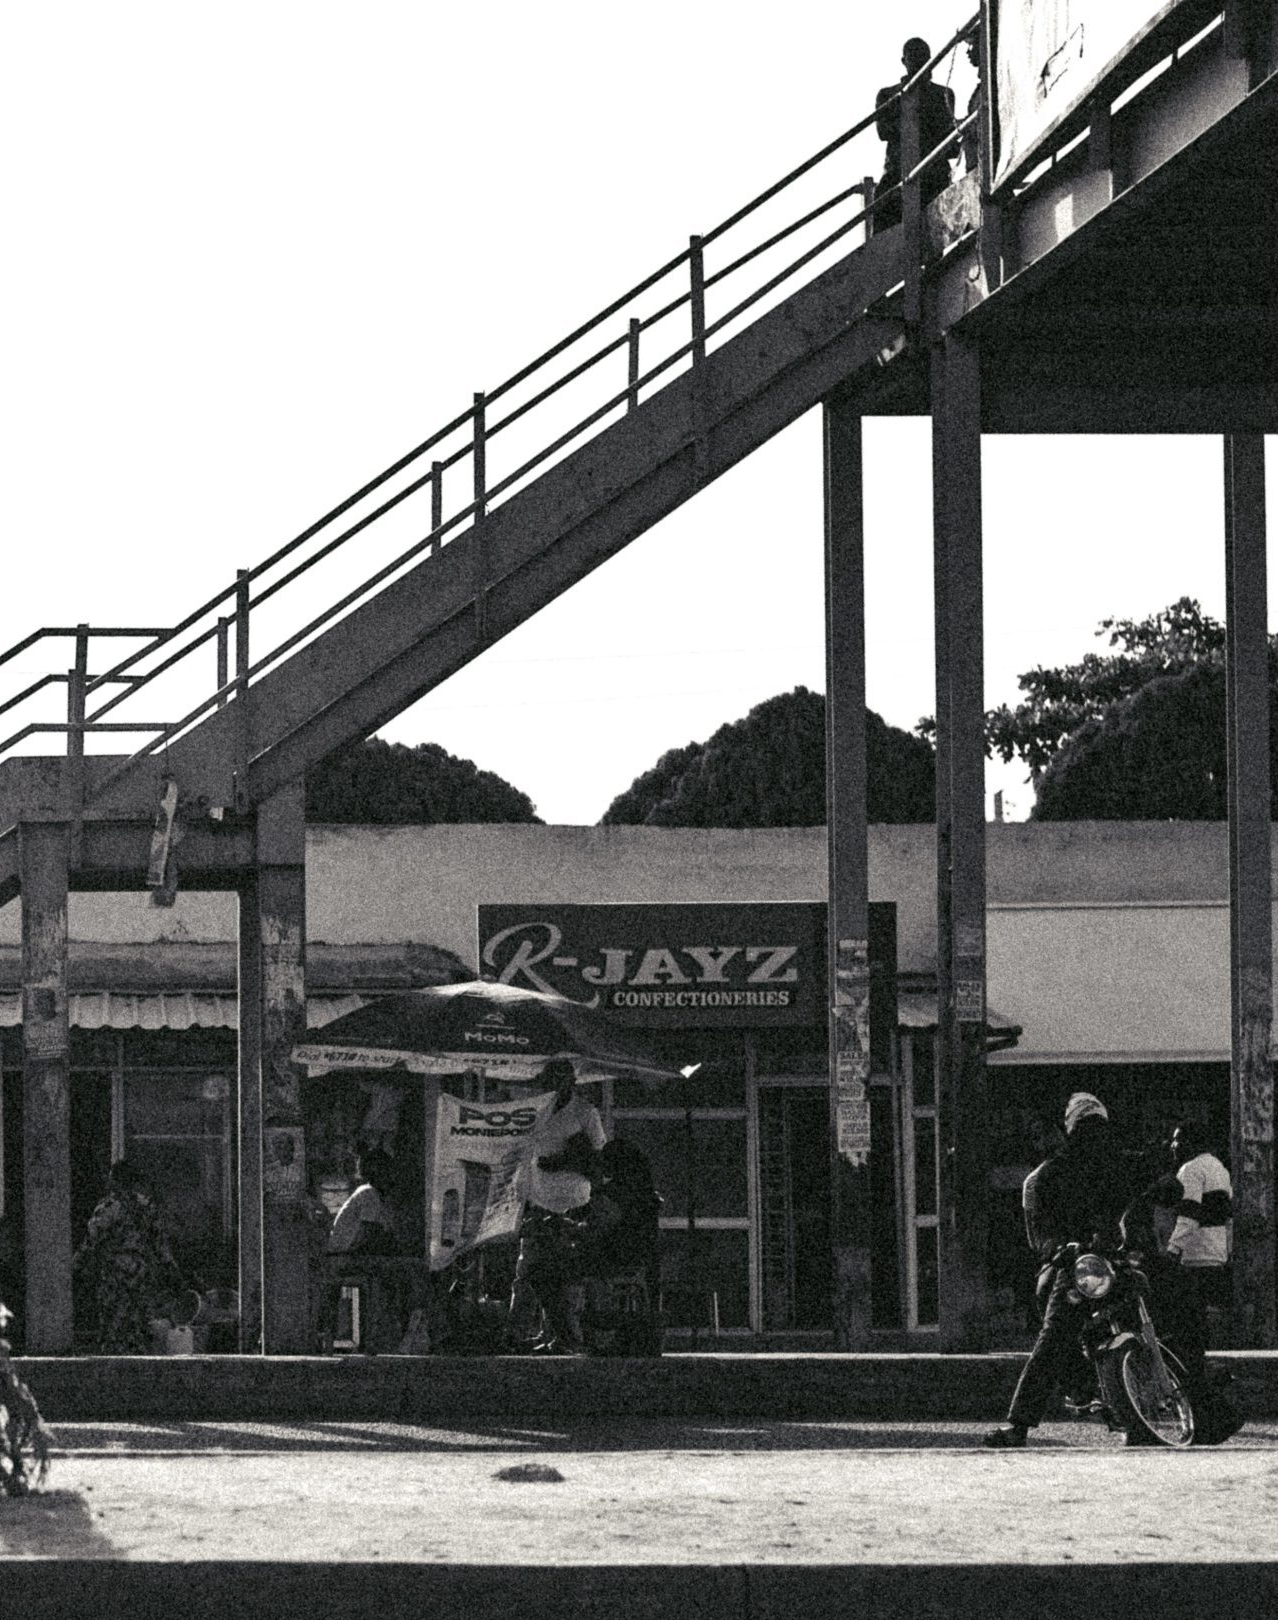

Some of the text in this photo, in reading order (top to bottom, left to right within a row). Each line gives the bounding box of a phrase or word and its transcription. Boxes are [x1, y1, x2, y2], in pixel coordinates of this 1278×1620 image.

[612, 990, 790, 1006] CONFECTIONERIES
[297, 1050, 321, 1062] Dial
[358, 1053, 370, 1063] to
[459, 1106, 537, 1126] POS
